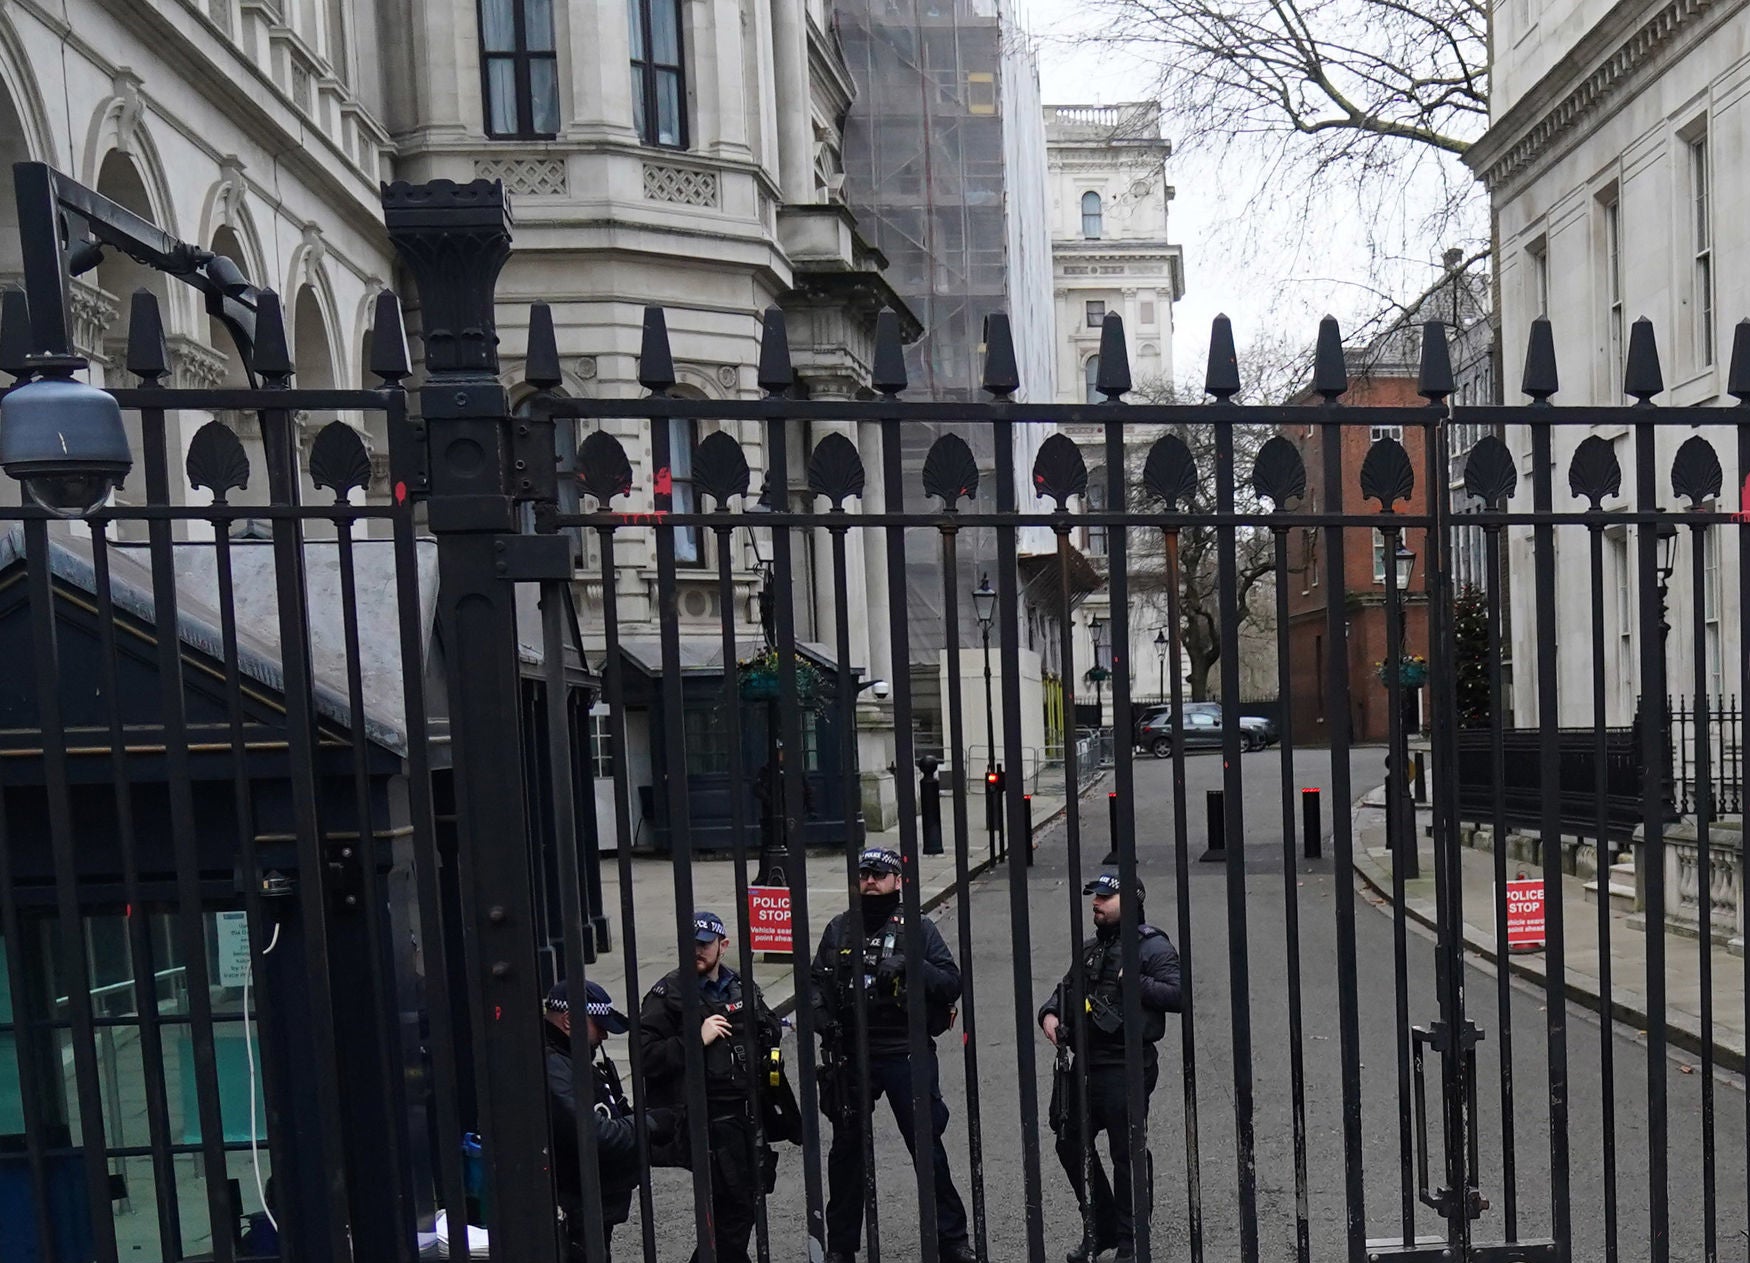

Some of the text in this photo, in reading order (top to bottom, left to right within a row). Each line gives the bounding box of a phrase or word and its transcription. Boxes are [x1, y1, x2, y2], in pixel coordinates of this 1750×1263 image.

[753, 897, 790, 908] POLIC
[1509, 902, 1539, 913] STOP
[759, 910, 792, 921] STOP
